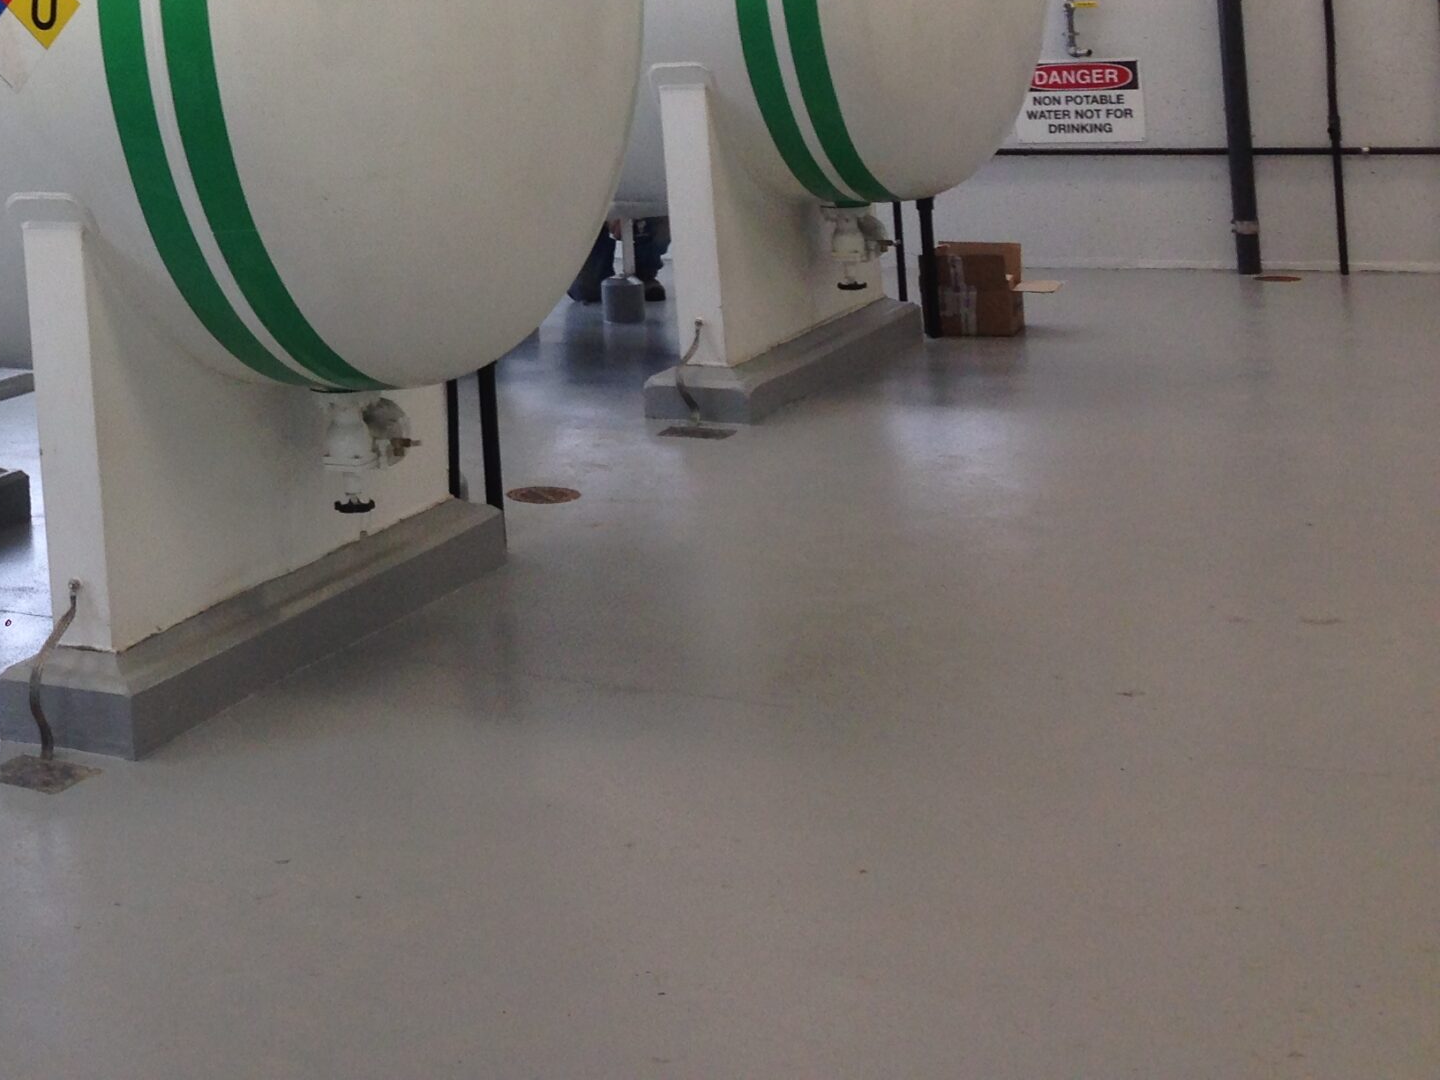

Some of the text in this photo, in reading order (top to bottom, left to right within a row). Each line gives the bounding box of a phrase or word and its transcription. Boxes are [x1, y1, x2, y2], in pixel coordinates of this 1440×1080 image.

[1034, 69, 1119, 86] DANGER
[1032, 94, 1125, 106] NON POTABLE
[1026, 108, 1134, 120] WATER NOT FOR
[1048, 123, 1113, 134] DRINKING
